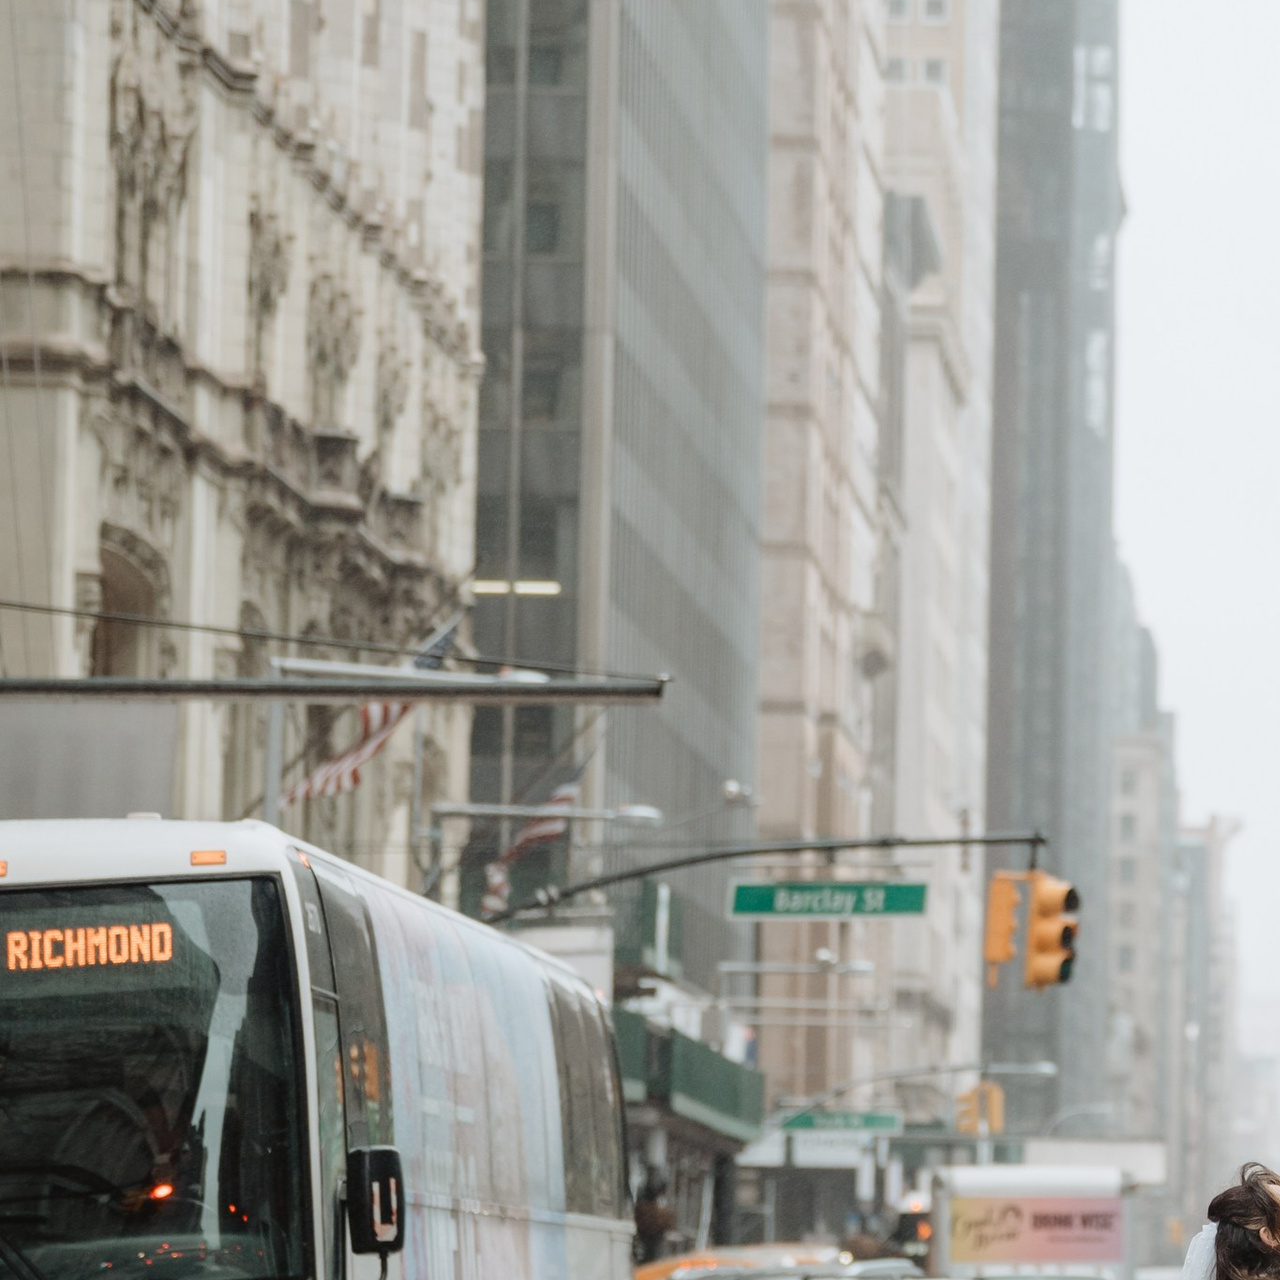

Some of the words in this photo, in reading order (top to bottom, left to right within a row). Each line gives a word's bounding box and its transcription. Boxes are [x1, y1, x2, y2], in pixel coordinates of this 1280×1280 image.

[773, 887, 856, 917] Barclay
[863, 888, 886, 911] St
[6, 921, 173, 971] RICHMOND
